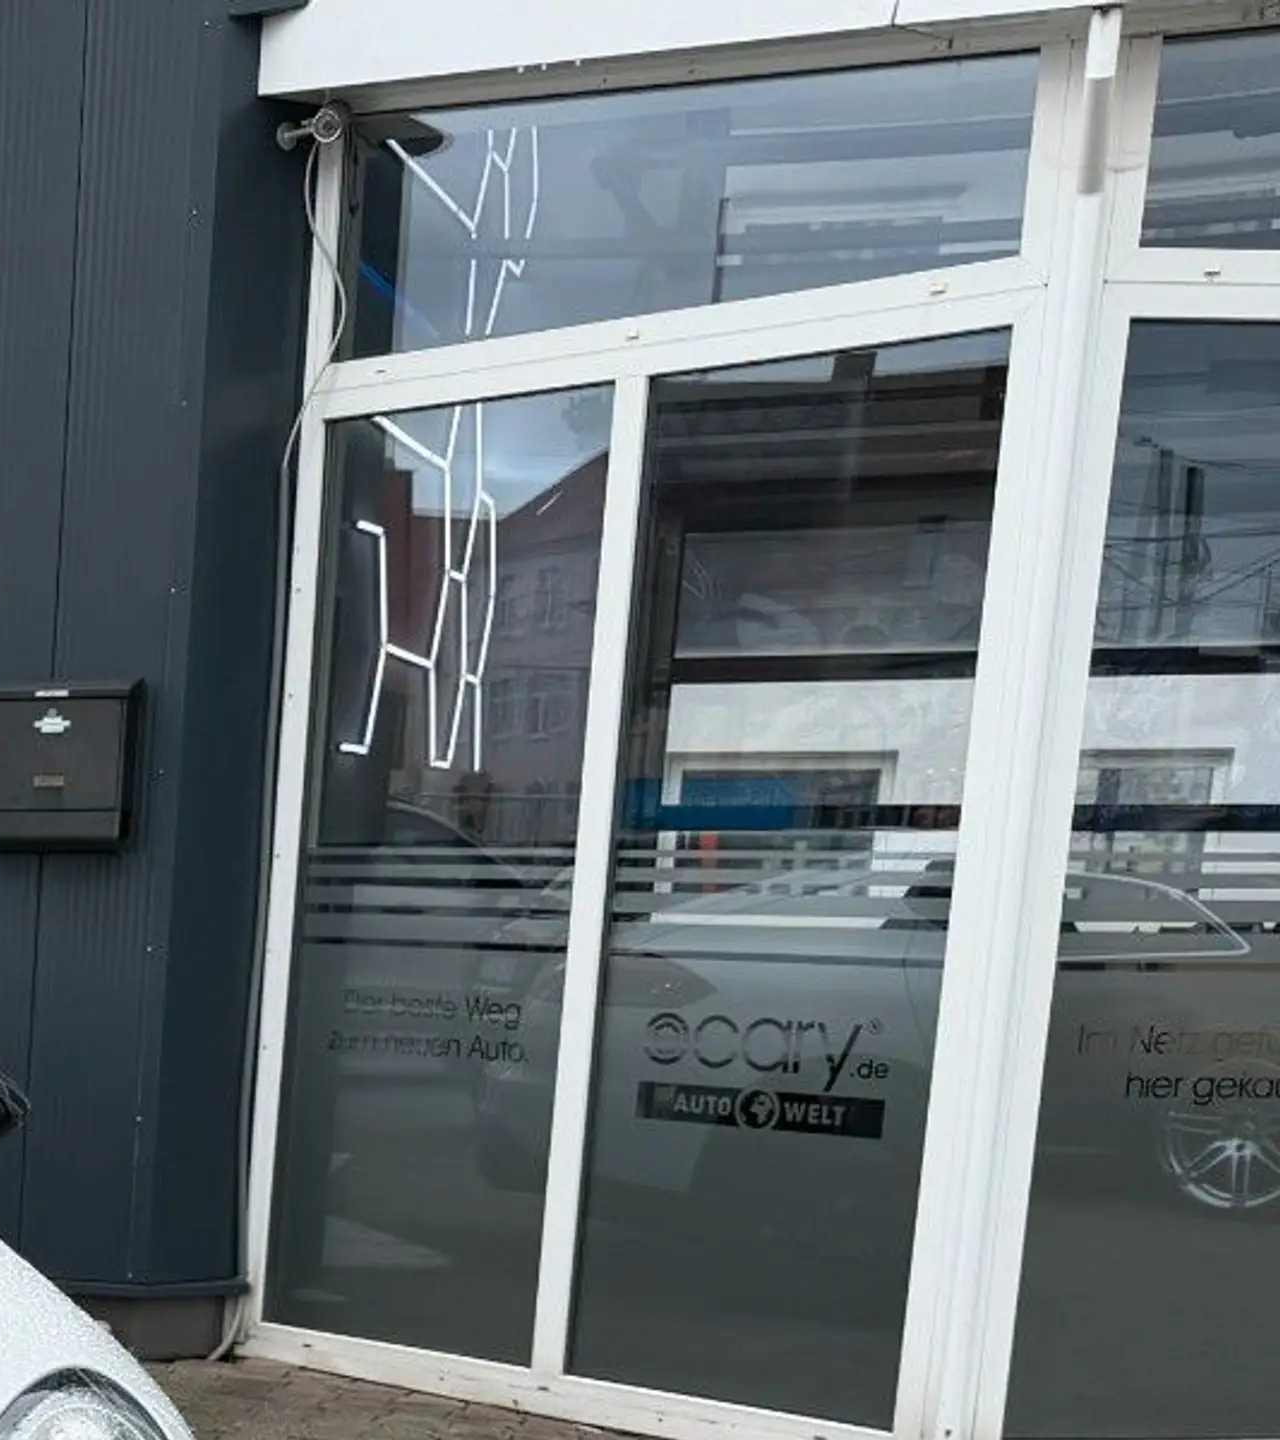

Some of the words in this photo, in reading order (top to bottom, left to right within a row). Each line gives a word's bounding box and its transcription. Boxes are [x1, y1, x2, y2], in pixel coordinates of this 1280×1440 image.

[465, 993, 522, 1031] Weg
[466, 1033, 530, 1062] Auto.
[1129, 1024, 1205, 1055] Netz
[1125, 1073, 1184, 1101] hier
[672, 1092, 733, 1117] AUTO
[783, 1101, 849, 1127] WELT
